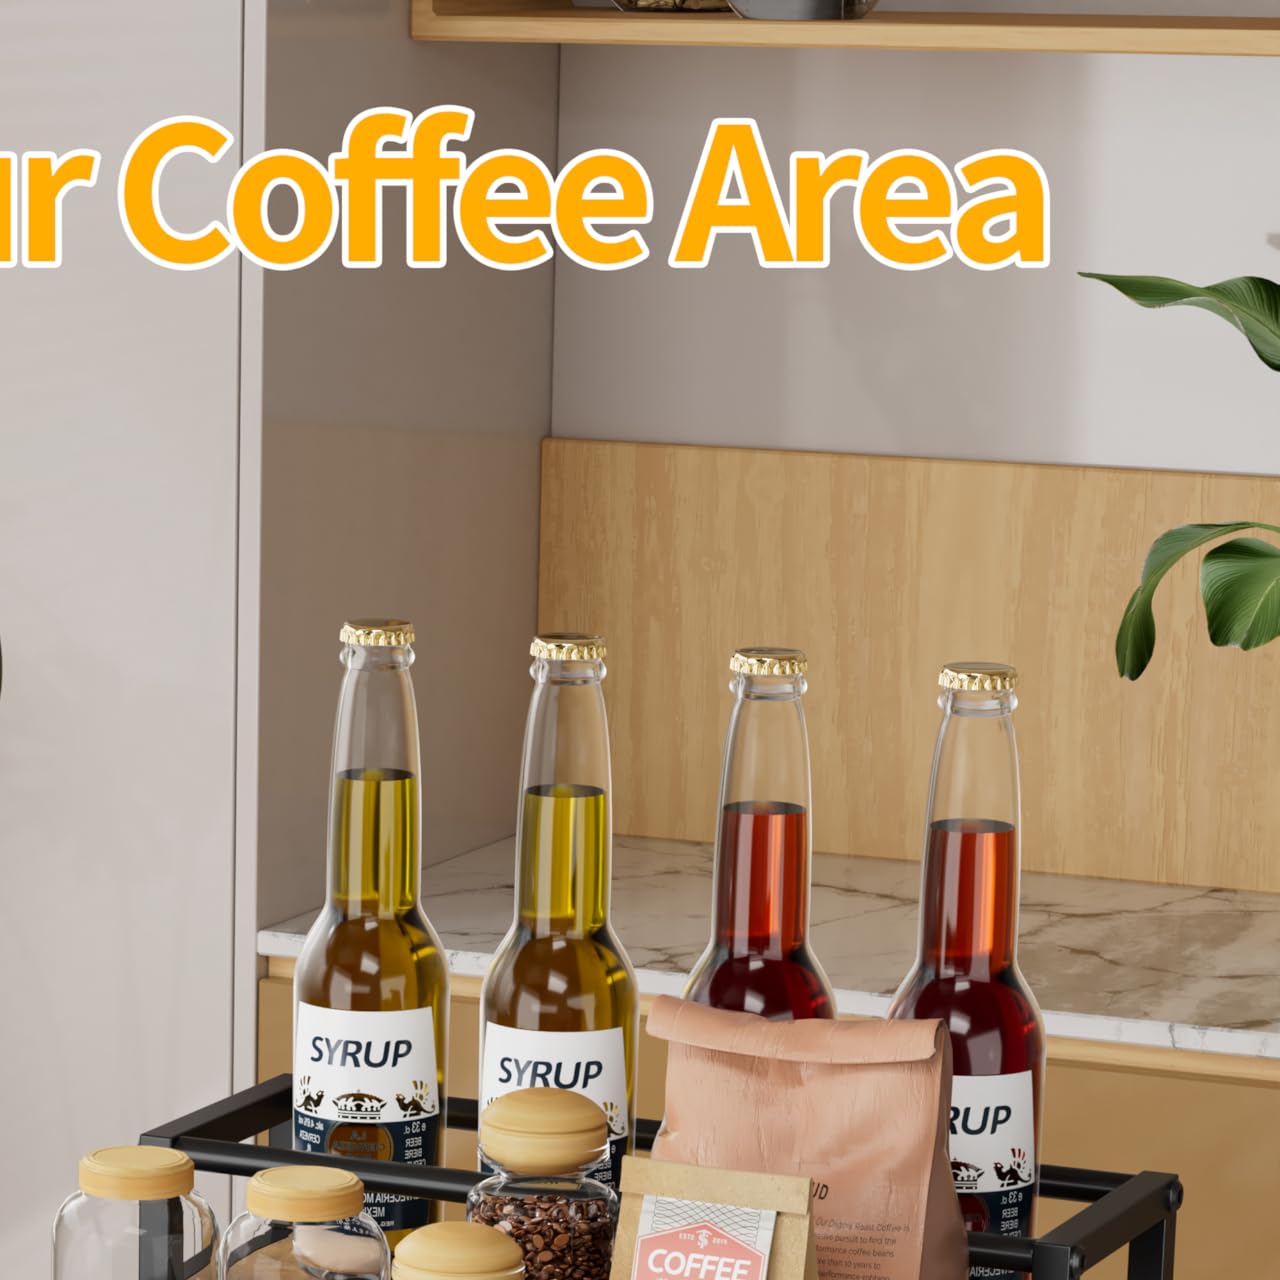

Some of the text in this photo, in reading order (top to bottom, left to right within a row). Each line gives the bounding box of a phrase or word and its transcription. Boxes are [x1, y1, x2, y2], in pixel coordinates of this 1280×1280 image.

[310, 1036, 413, 1069] SYRUP
[498, 1057, 603, 1089] SYRUP
[949, 1105, 1012, 1135] RUP
